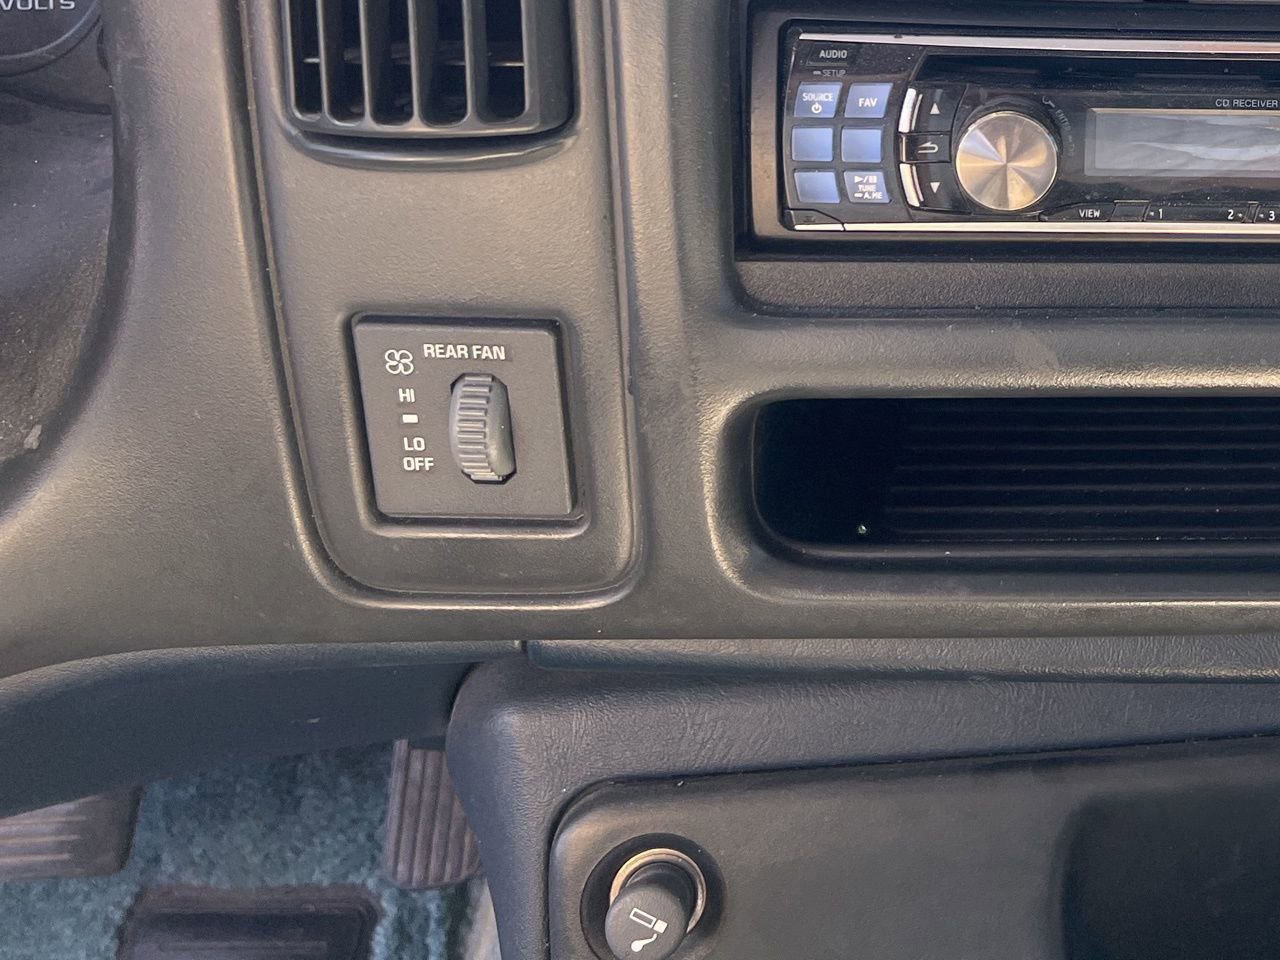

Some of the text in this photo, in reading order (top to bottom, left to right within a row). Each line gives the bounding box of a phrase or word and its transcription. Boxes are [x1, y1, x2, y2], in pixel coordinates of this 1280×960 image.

[819, 49, 848, 59] AUDIO
[822, 69, 847, 77] SETUP
[802, 92, 834, 102] SOURCE
[858, 97, 878, 107] FAV
[1215, 99, 1229, 108] CD
[1233, 99, 1278, 108] RECEIVER
[1079, 208, 1101, 218] VIEW
[1158, 208, 1163, 219] 1
[1227, 209, 1234, 220] 2
[1268, 210, 1276, 221] 3
[423, 343, 506, 360] REAR FAN
[398, 388, 416, 403] HI
[403, 437, 425, 451] LO
[403, 457, 434, 471] OFF
